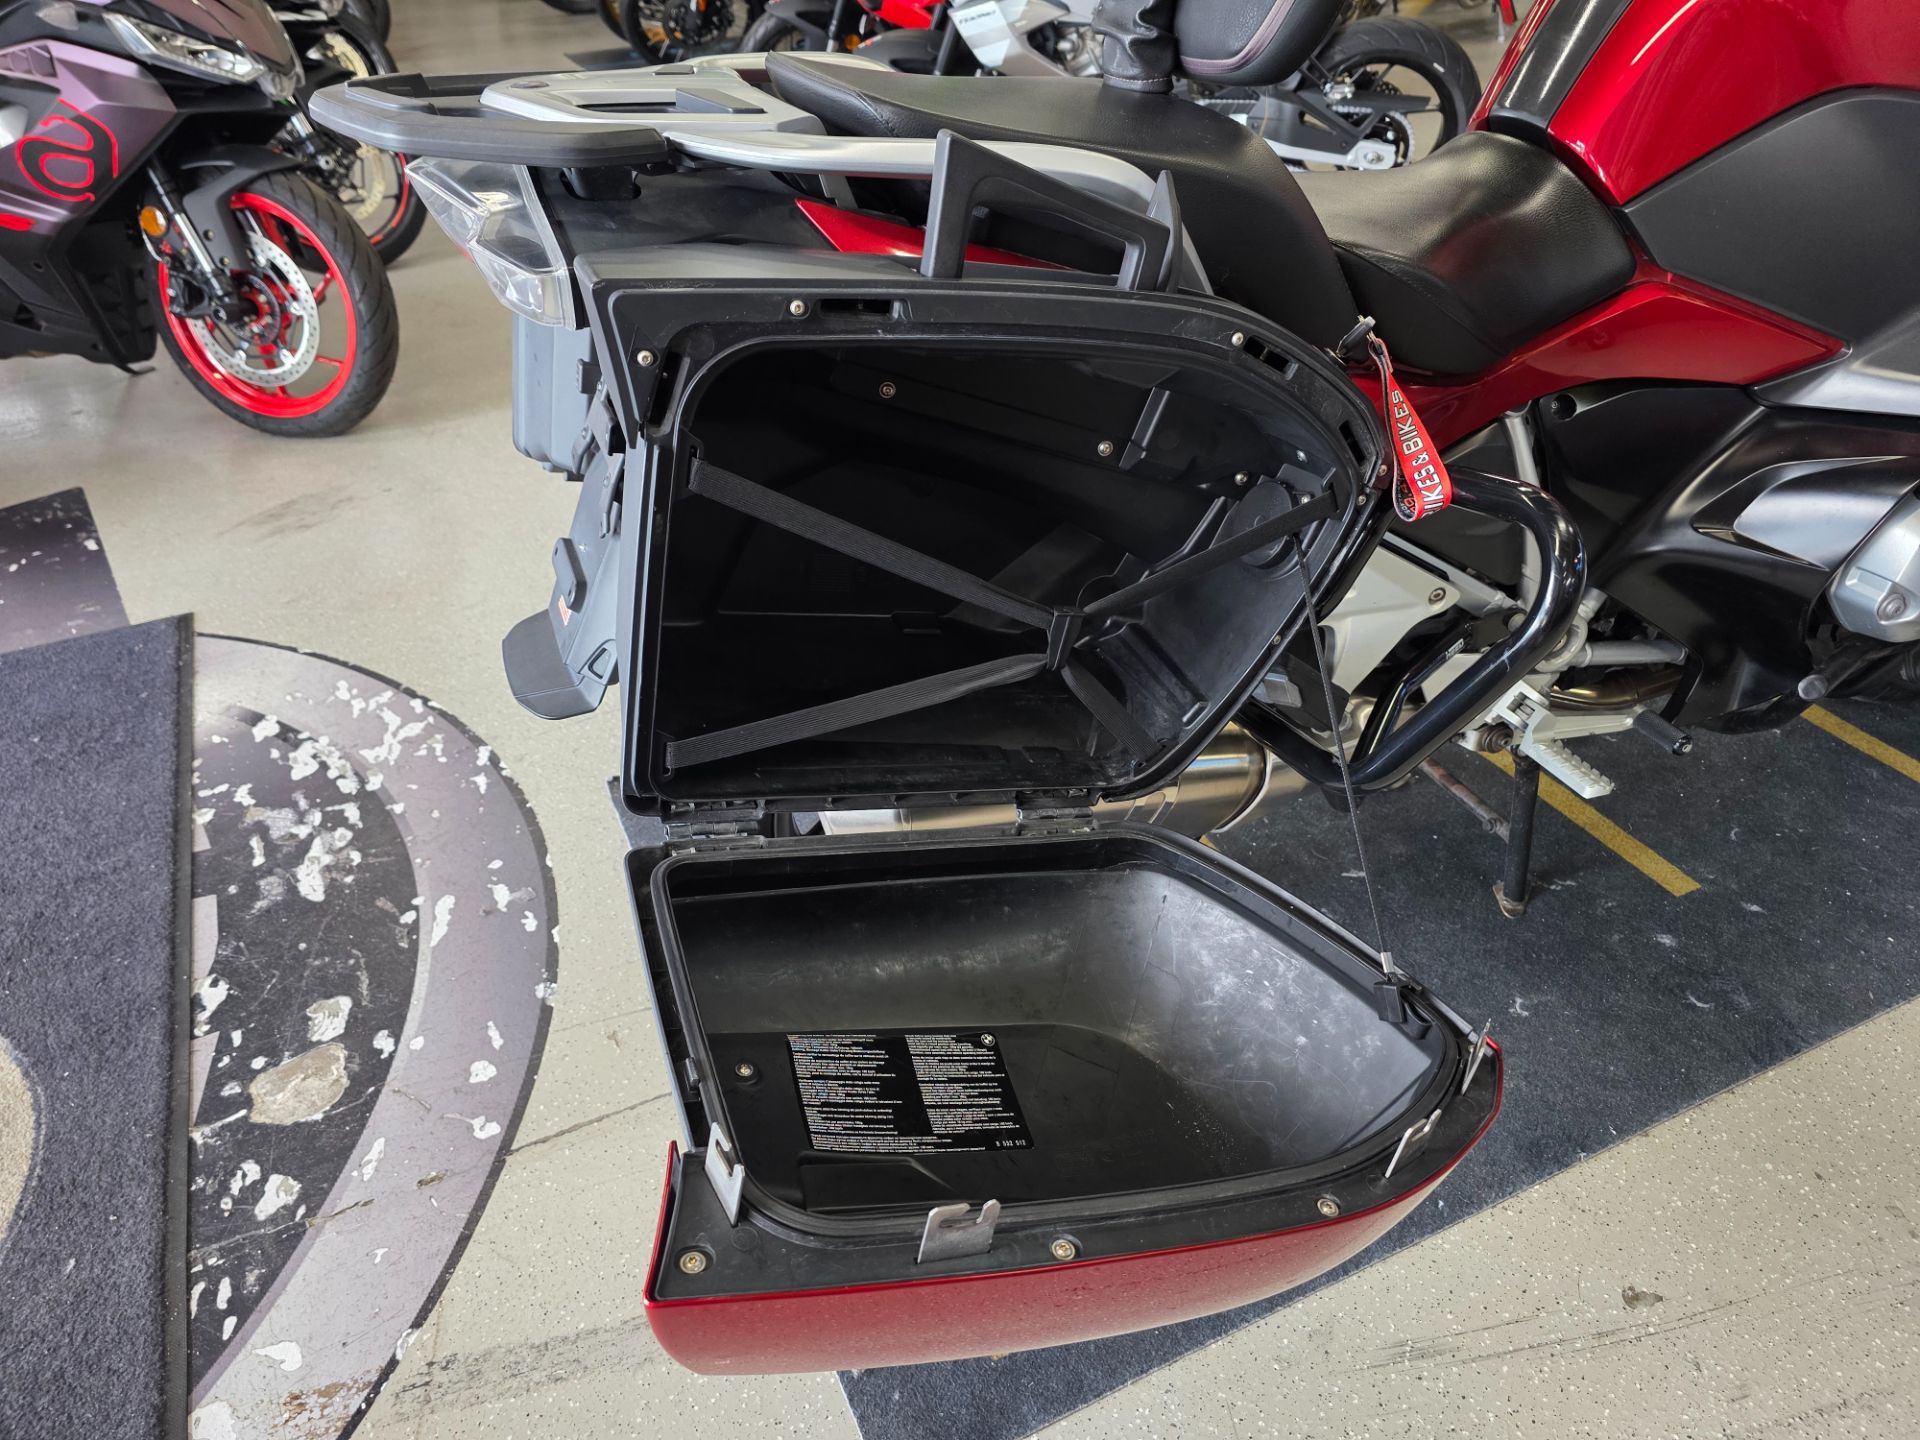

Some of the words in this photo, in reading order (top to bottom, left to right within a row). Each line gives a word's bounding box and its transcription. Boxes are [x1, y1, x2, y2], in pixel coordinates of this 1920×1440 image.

[1391, 390, 1425, 456] BIKES
[1412, 451, 1429, 466] &
[1414, 465, 1444, 519] IKES
